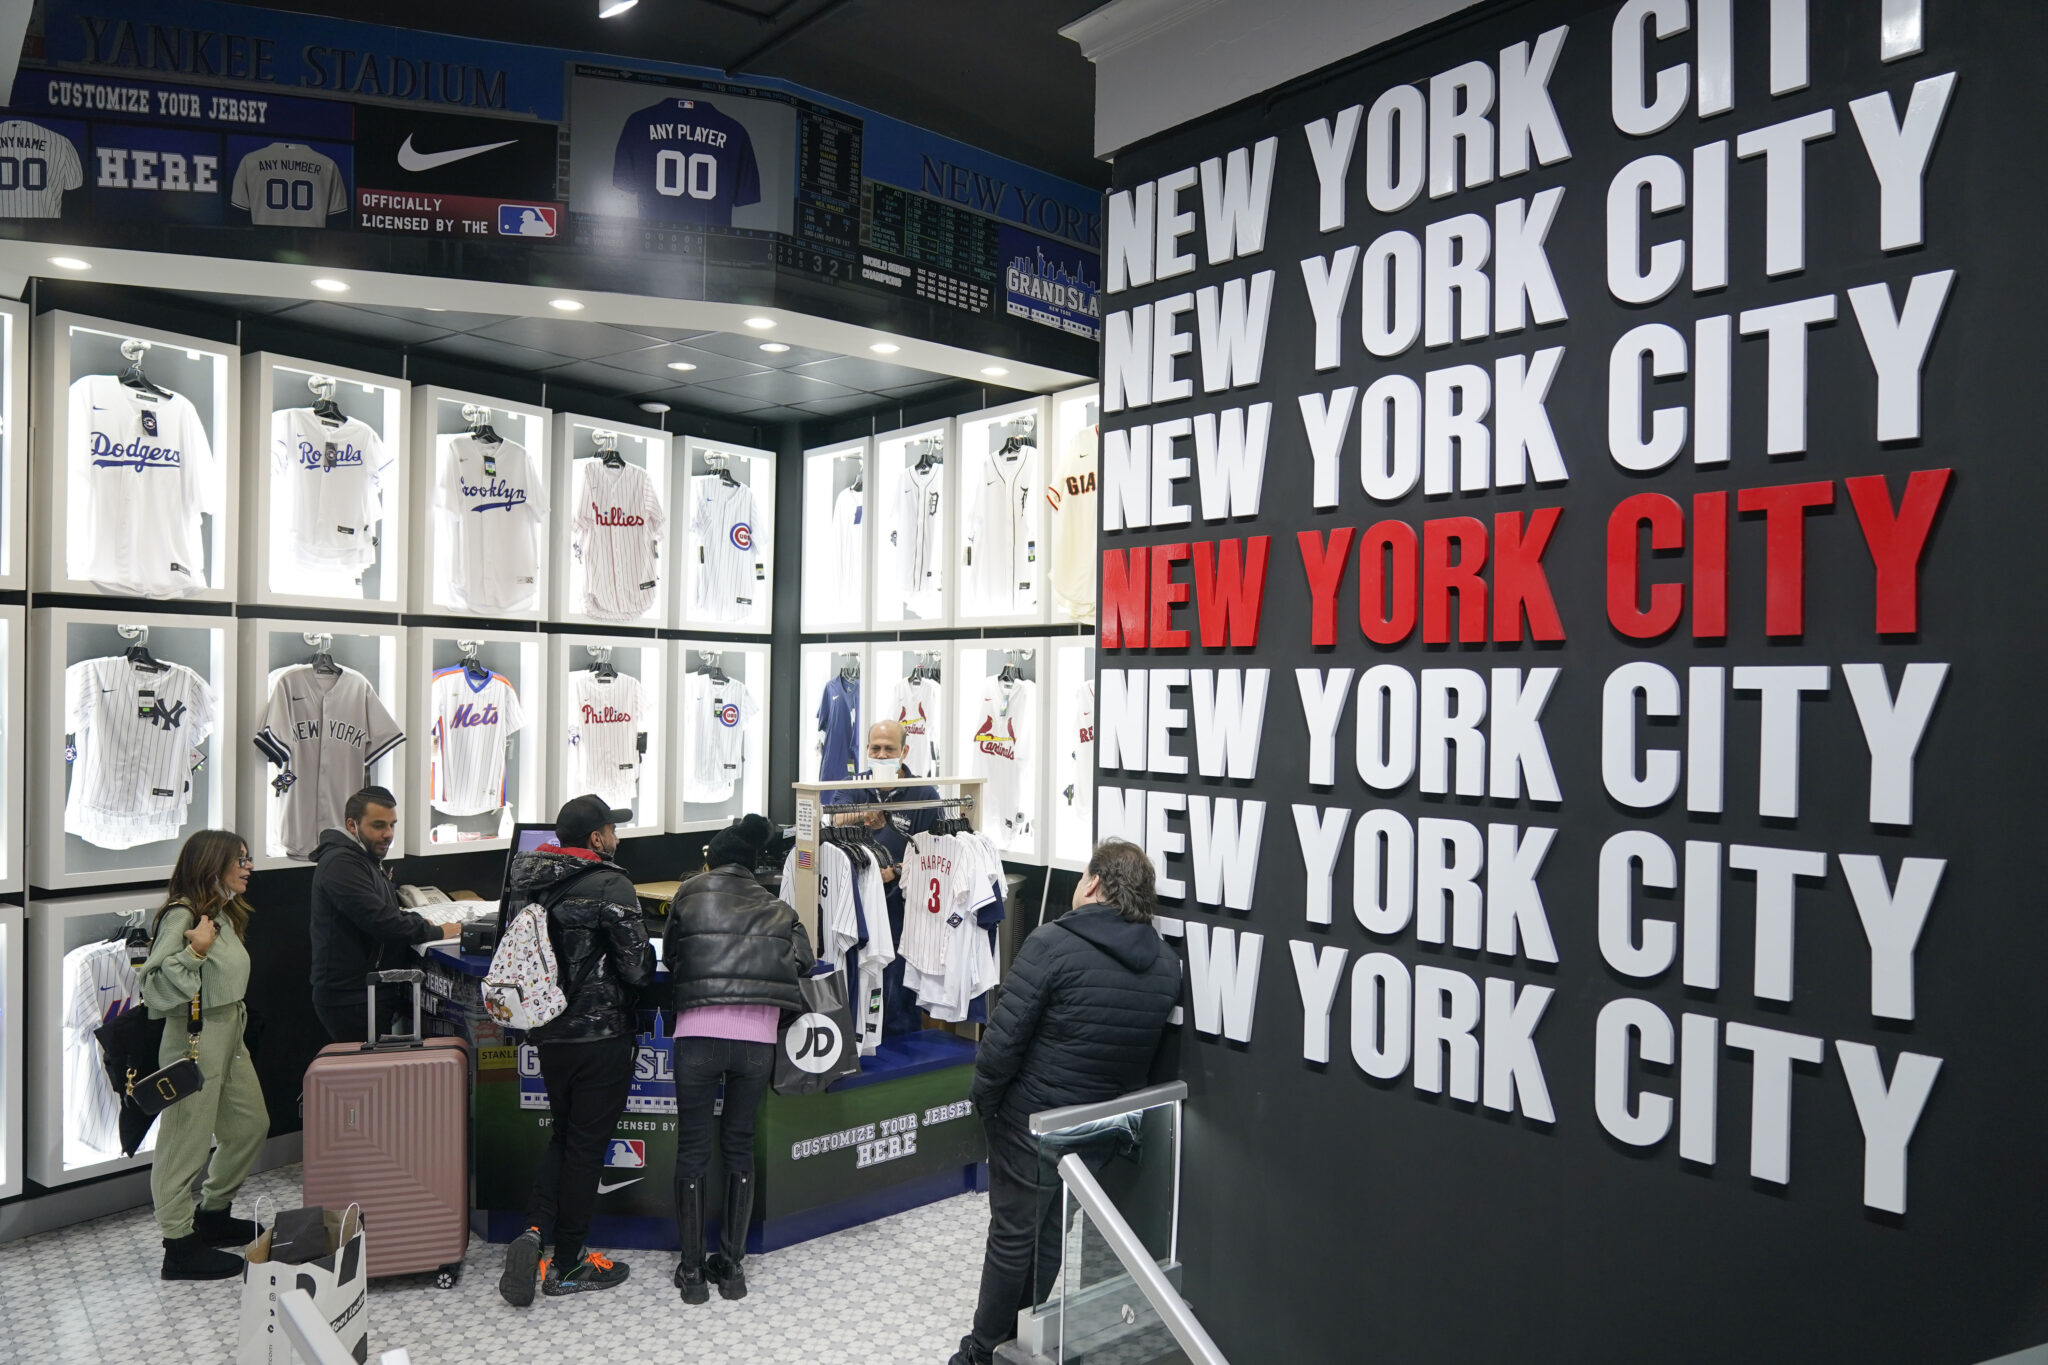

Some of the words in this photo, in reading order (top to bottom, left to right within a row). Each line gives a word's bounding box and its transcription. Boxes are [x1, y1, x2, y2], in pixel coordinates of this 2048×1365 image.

[77, 14, 277, 82] YANKEE
[300, 44, 508, 109] STADIUM
[48, 80, 150, 114] CUSTOMIZE
[157, 91, 202, 118] YOUR
[208, 96, 268, 124] JERSEY
[17, 137, 48, 151] NAME
[649, 123, 674, 141] ANY
[677, 123, 727, 149] PLAYER
[95, 146, 219, 193] HERE
[258, 159, 278, 173] ANY
[280, 159, 321, 176] NUMBER
[655, 149, 718, 201] 00
[1108, 137, 1278, 293] NEW
[1305, 25, 1572, 233] YORK
[266, 178, 314, 211] 00
[362, 193, 443, 213] OFFICIALLY
[919, 152, 1009, 216] NEW
[1014, 185, 1101, 247] YORK
[361, 215, 429, 233] LICENSED
[435, 218, 454, 233] BY
[462, 220, 488, 234] THE
[1106, 270, 1276, 412] NEW
[1301, 186, 1570, 371] YORK
[1606, 71, 1958, 305] CITY
[813, 255, 822, 272] 3
[829, 259, 839, 277] 2
[847, 263, 853, 280] 1
[862, 254, 888, 271] WORLD
[1008, 268, 1065, 307] GRAND
[1104, 402, 1272, 532] NEW
[1298, 345, 1570, 508] YORK
[1606, 269, 1958, 471] CITY
[90, 430, 181, 473] Dodgers
[299, 441, 362, 473] Roals
[460, 476, 526, 511] rooklyn
[592, 501, 644, 527] hillies
[1101, 535, 1270, 649] NEW
[1297, 506, 1566, 646] YORK
[1606, 467, 1955, 639] CITY
[449, 702, 499, 731] Mets
[581, 704, 631, 725] Phillies
[328, 719, 367, 749] YORK
[979, 740, 1015, 761] Cardinals
[1098, 668, 1270, 781] NEW
[1294, 664, 1563, 803] YORK
[1601, 661, 1951, 826] CITY
[920, 853, 952, 876] HARPER
[927, 877, 941, 914] 3
[1097, 785, 1266, 912] NEW
[1292, 803, 1560, 964] YORK
[1597, 829, 1951, 1021] CITY
[425, 972, 454, 1000] JERSEY
[795, 1026, 835, 1060] JD
[1289, 939, 1556, 1126] YORK
[1594, 997, 1944, 1215] CITY
[662, 1122, 676, 1132] BY
[791, 1123, 876, 1160] CUSTOMIZE
[879, 1112, 919, 1138] YOUR
[921, 1099, 974, 1127] JERSEY
[856, 1129, 917, 1169] HERE
